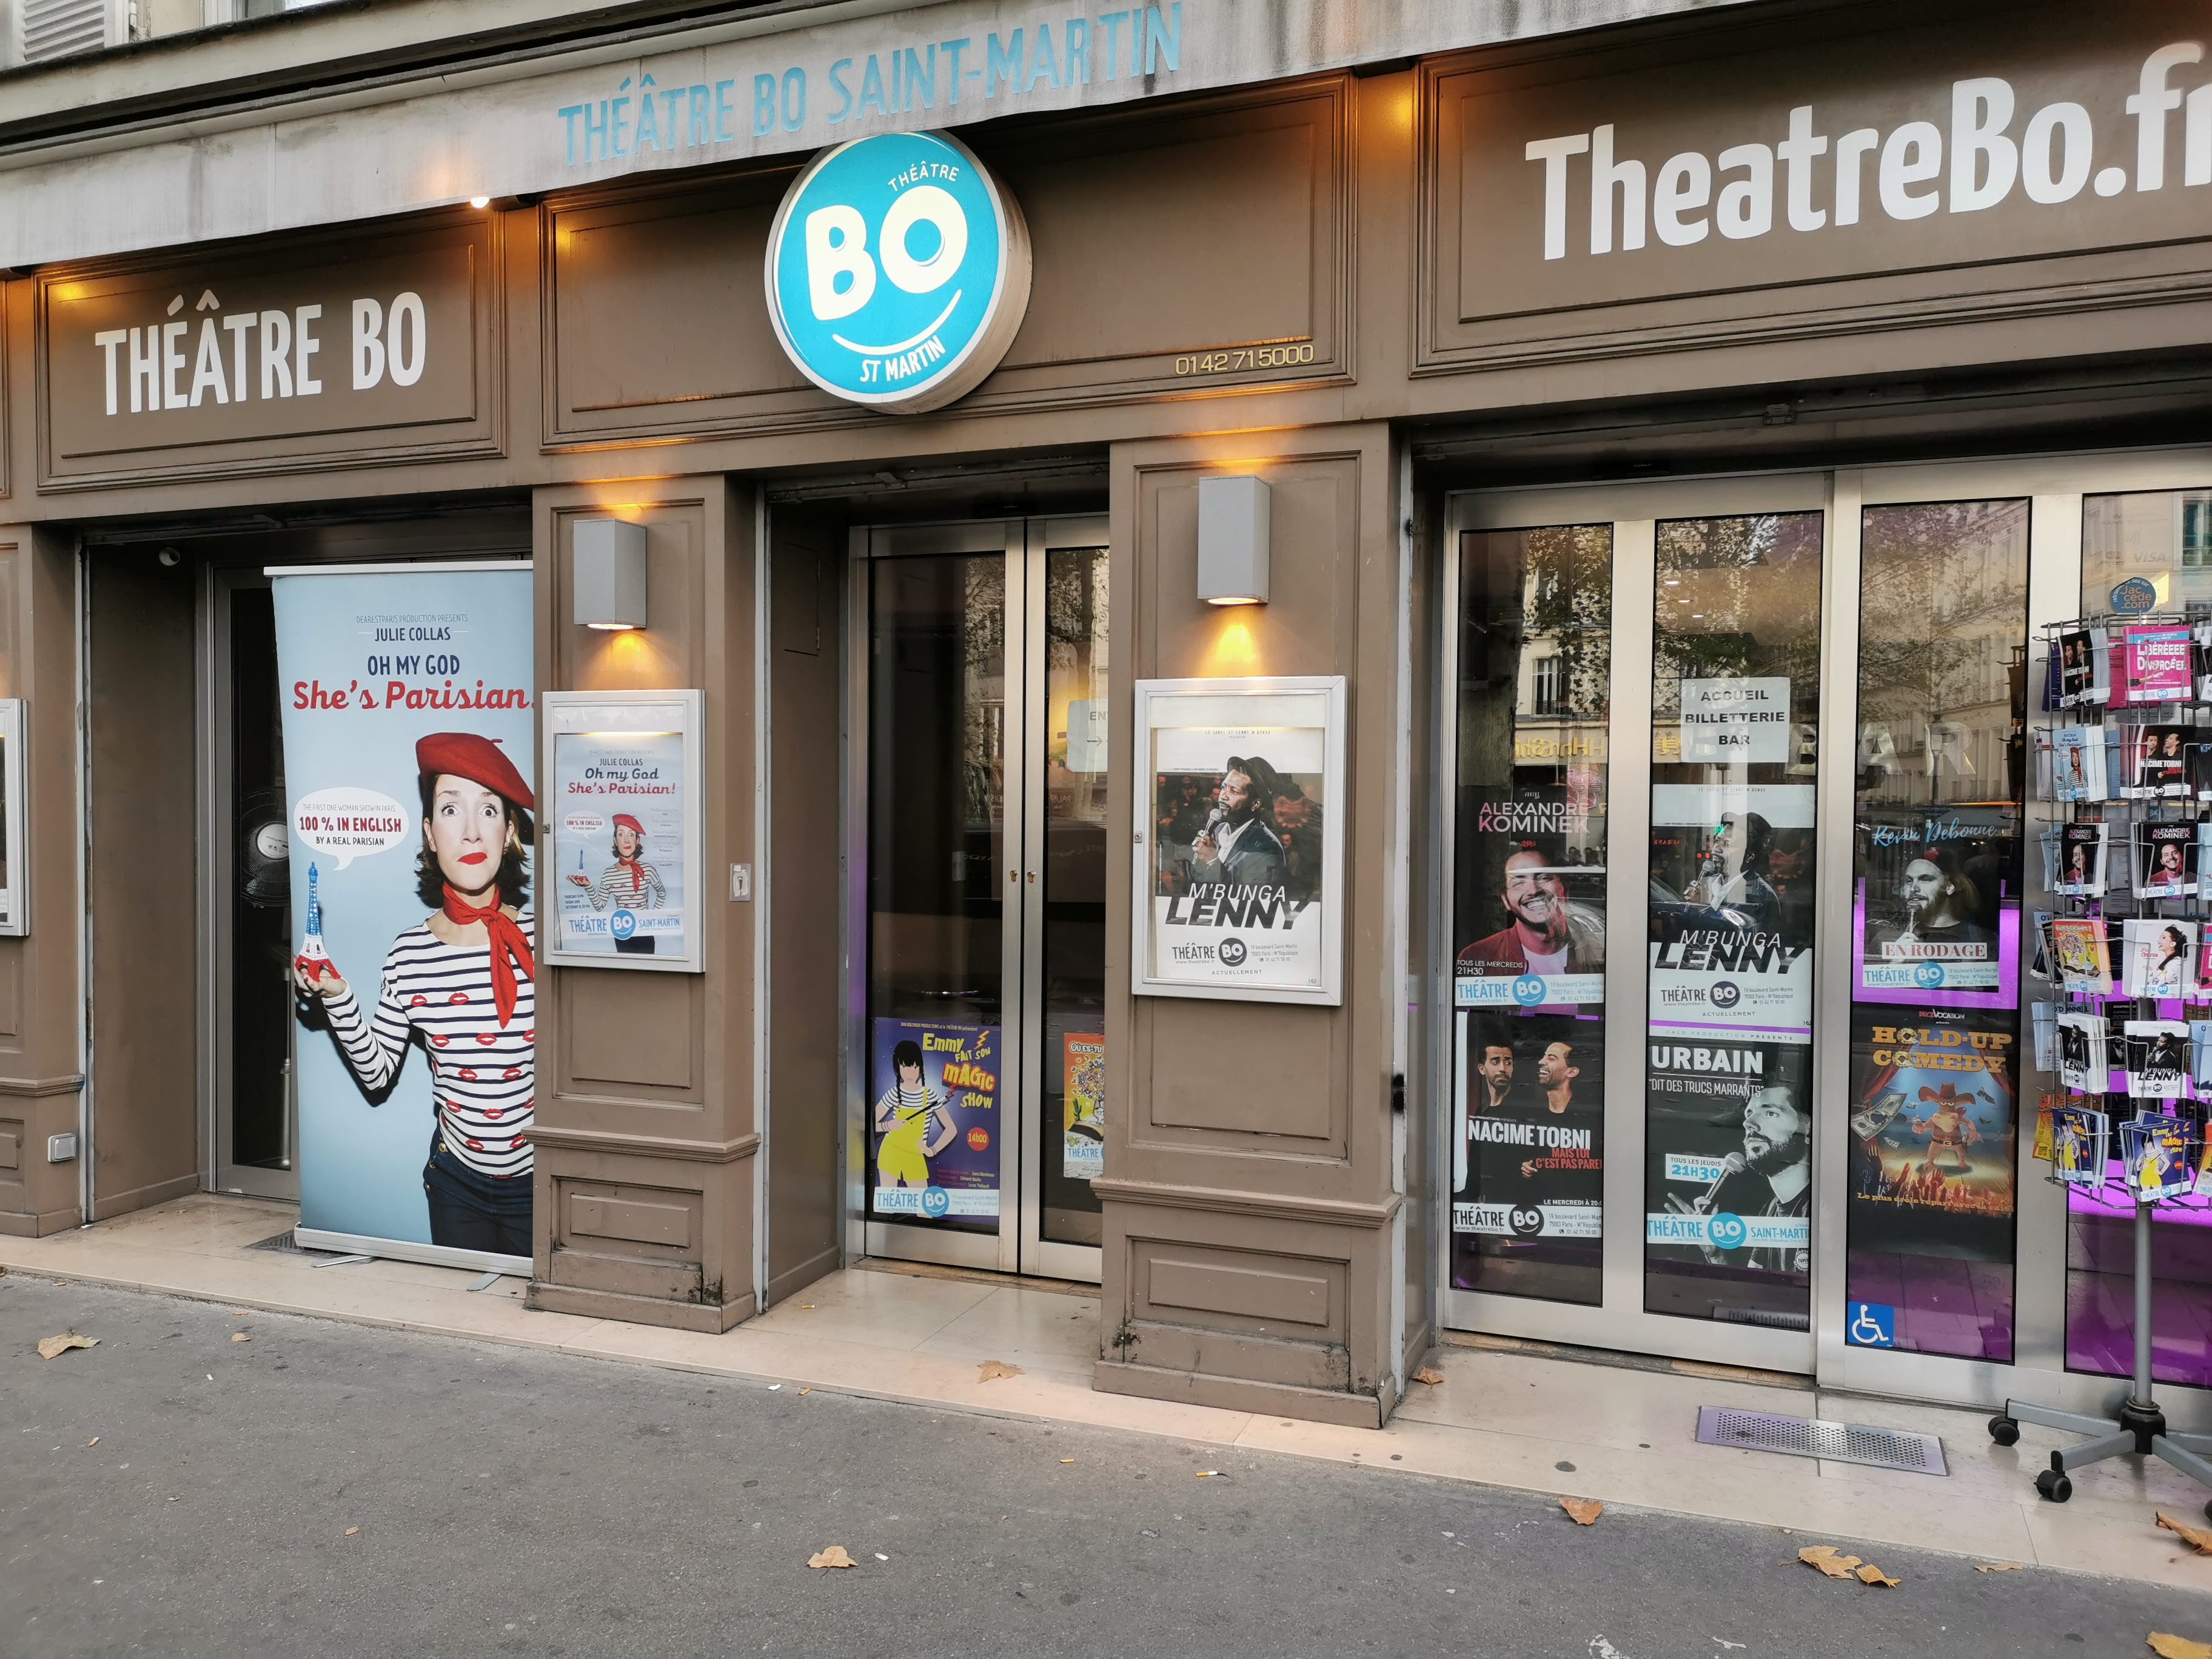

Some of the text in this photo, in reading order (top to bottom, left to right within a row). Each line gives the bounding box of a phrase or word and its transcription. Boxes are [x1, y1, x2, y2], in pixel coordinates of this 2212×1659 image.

[558, 2, 1182, 168] THÉÂTRE BO SAINT-MARTIN
[888, 161, 959, 192] THÉÂTRE
[805, 185, 968, 321] BO
[95, 289, 426, 416] THÉÂTRE BO
[860, 335, 946, 382] ST MARTIN
[2134, 552, 2167, 563] VISA
[2120, 586, 2142, 594] Jac
[2123, 593, 2152, 602] cede
[2121, 600, 2150, 609] .com
[375, 627, 451, 642] JULIE COLLAS
[367, 654, 460, 675] OH MY GOD
[293, 680, 379, 709] She's
[1700, 690, 1769, 702] ACCUEIL
[1685, 712, 1785, 723] BILLETTERIE
[1718, 735, 1751, 746] BAR
[585, 768, 659, 782] Oh my God
[568, 782, 675, 794] She's Parisian!
[1480, 802, 1589, 816] ALEXANDRE
[300, 817, 401, 832] 100 % IN ENGLISH
[1479, 816, 1590, 833] KOMINEK
[1926, 817, 1997, 843] Debonne
[353, 837, 384, 846] PARISIAN
[1188, 883, 1285, 902] M'BUNGA
[1165, 897, 1310, 930] LENNY
[569, 915, 680, 933] THÉÂTRE BO SAINT-MARTIN
[1680, 930, 1781, 948] M'BUNGA
[1171, 942, 1243, 959] THÉÂTRE BO
[1654, 942, 1807, 974] LENNY
[1886, 944, 1985, 957] EN RODAGE
[1865, 967, 1910, 982] THÉÂTRE
[1918, 968, 1940, 980] BO
[1457, 979, 1542, 999] THÉÂTRE BO
[1661, 985, 1736, 1002] THÉÂTRE BO
[923, 1033, 965, 1053] Emmy
[1872, 1027, 2013, 1050] HOLD-UP
[954, 1047, 991, 1062] FAIT SON
[1070, 1043, 1102, 1053] OÙ ES-TU
[1652, 1045, 1763, 1074] URBAIN
[1872, 1050, 2006, 1073] COMEDY
[1667, 1079, 1682, 1092] DES
[1684, 1081, 1712, 1094] TRUCS
[968, 1133, 987, 1143] 14h00
[1468, 1120, 1590, 1150] NACIME TOBNI
[1068, 1145, 1099, 1158] THÉÂTRE
[1552, 1148, 1590, 1158] MAIS TOI
[1536, 1158, 1559, 1168] C'EST
[1561, 1158, 1577, 1169] PAS
[1672, 1165, 1720, 1181] 21H30
[877, 1189, 918, 1207] THÉÂTRE
[925, 1193, 945, 1207] BO
[1872, 1193, 1892, 1202] plus
[1894, 1196, 1919, 1204] drôle
[1453, 1206, 1540, 1227] THÉÂTRE BO
[1647, 1216, 1809, 1239] THÉÂTRE BO SAINT-MARTI
